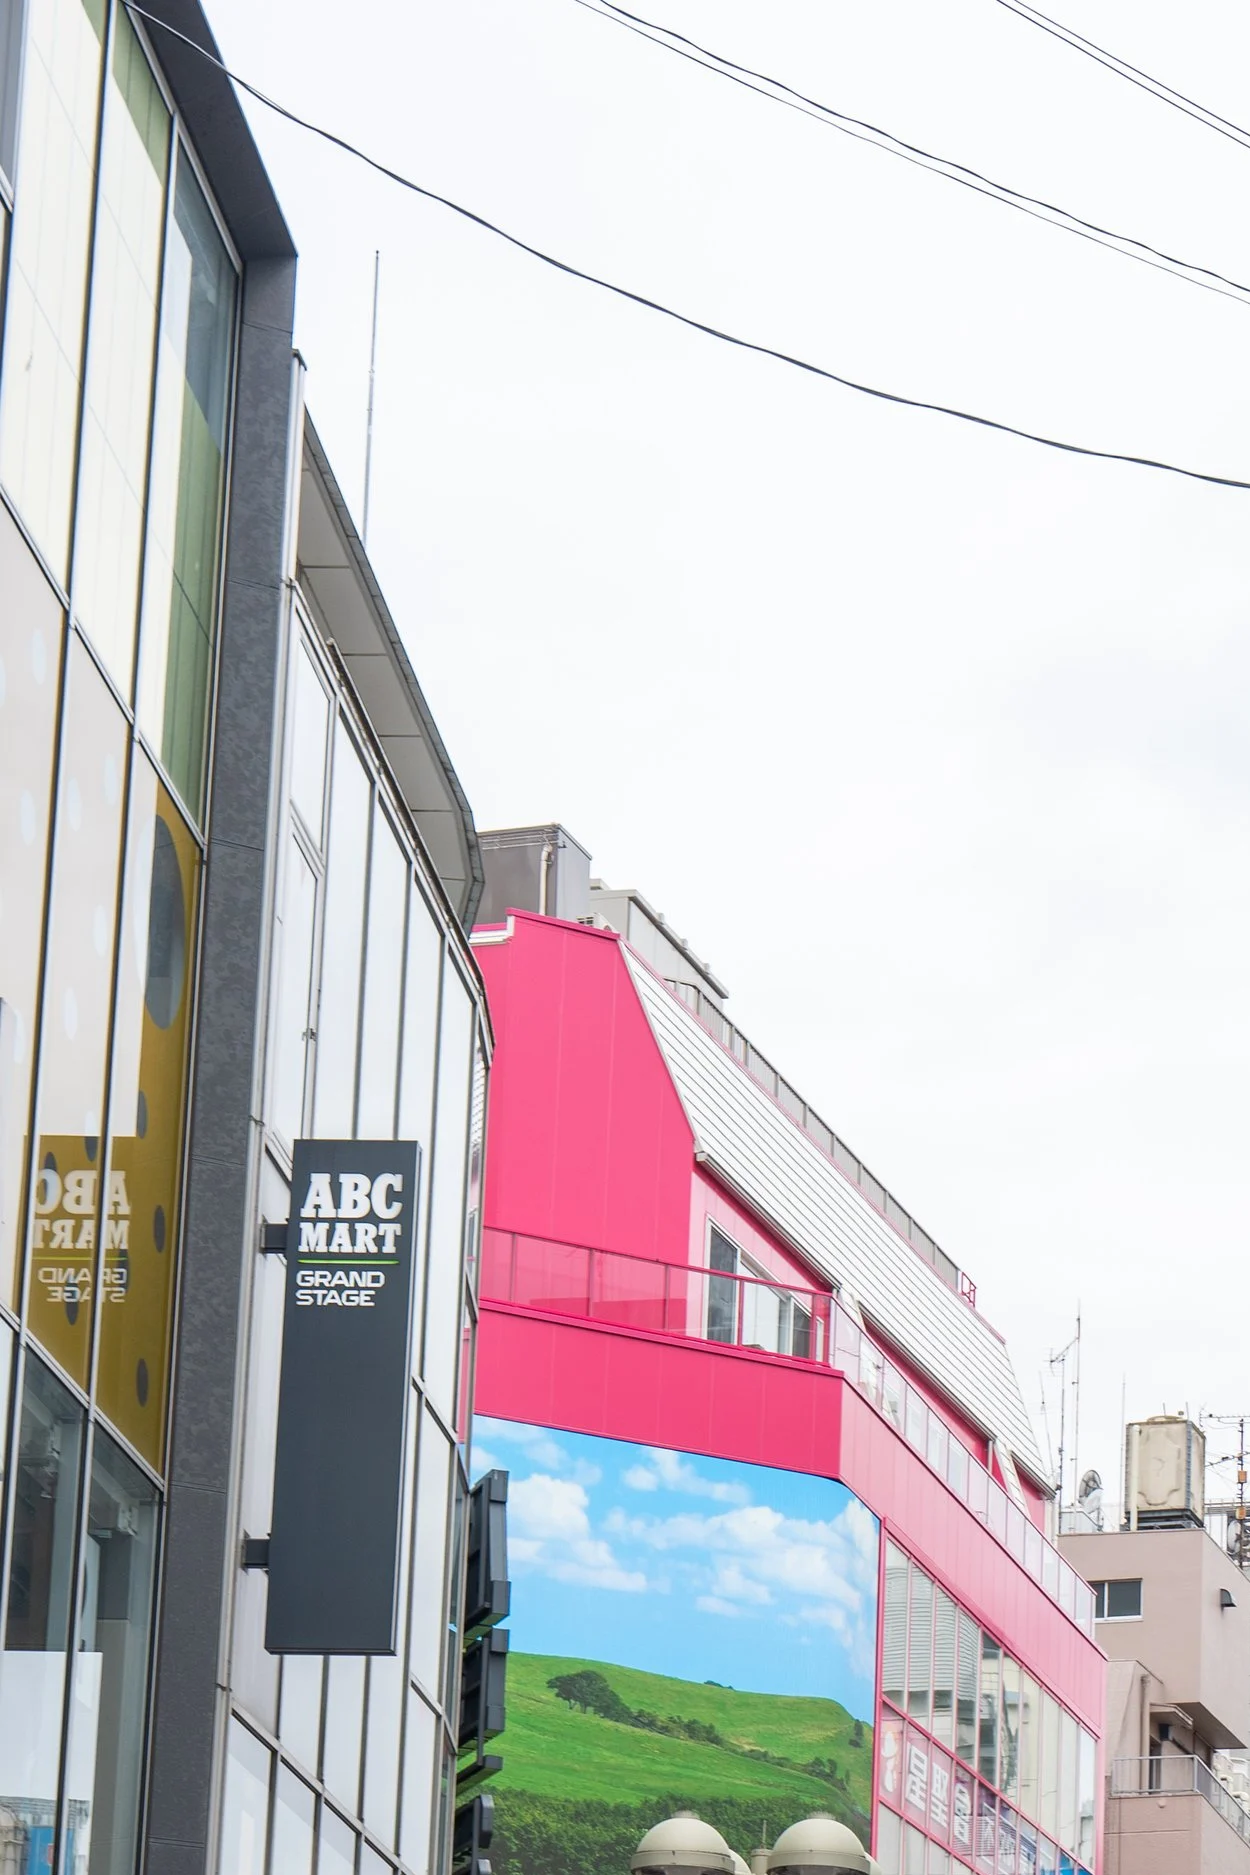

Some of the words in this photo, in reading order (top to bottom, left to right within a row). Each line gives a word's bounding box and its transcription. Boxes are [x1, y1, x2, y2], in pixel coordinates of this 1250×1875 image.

[301, 1173, 402, 1219] ABC
[299, 1223, 401, 1254] MART
[296, 1270, 386, 1288] GRAND
[296, 1289, 376, 1307] STAGE
